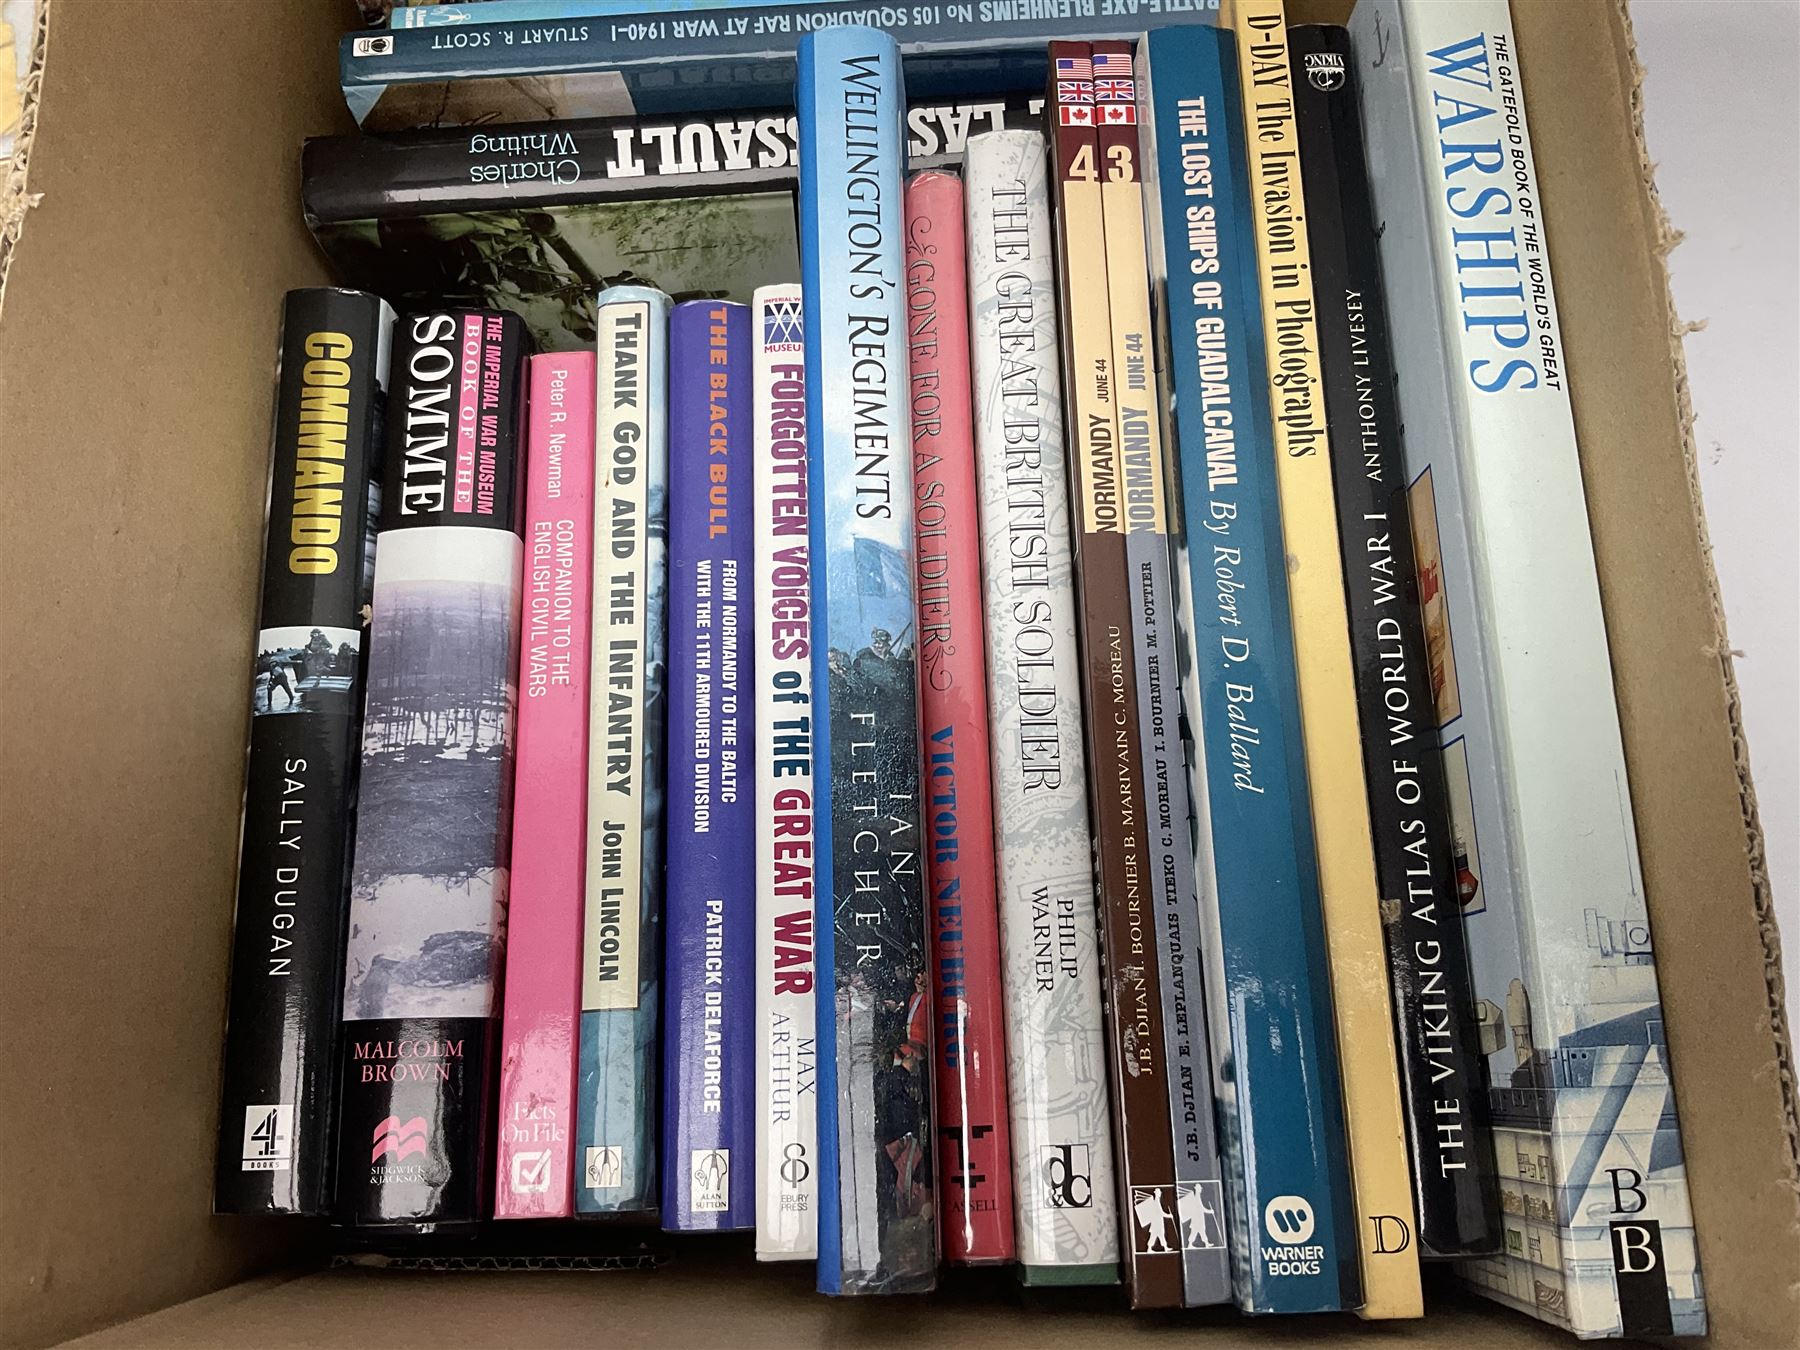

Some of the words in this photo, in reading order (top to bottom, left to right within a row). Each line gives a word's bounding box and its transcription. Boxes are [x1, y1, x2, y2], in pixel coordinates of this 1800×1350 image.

[498, 30, 515, 46] R.
[521, 26, 589, 45] STUART
[672, 18, 720, 38] WAR
[724, 17, 749, 36] AT
[754, 14, 791, 35] RAF
[796, 8, 907, 32] SQUADRON
[913, 6, 941, 26] 105
[950, 4, 973, 22] No
[980, 0, 1096, 21] BLENHEIMS
[431, 31, 491, 51] SCOTT
[1247, 13, 1289, 89] D-DAY
[1493, 33, 1510, 62] THE
[1178, 96, 1208, 137] THE
[1255, 97, 1297, 142] The
[1498, 64, 1522, 145] GATEFOLD
[469, 131, 580, 158] Whiting
[1069, 145, 1098, 182] 4
[1108, 145, 1135, 182] 3
[1181, 142, 1213, 199] LOST
[1510, 148, 1530, 193] BOOK
[470, 159, 581, 189] Charles
[840, 53, 896, 300] WELLINGTON'S
[1260, 149, 1303, 253] Invasion
[991, 179, 1029, 263] THE
[1424, 31, 1539, 394] WARSHIPS
[1518, 197, 1534, 220] OF
[1186, 205, 1218, 276] SHIPS
[1522, 223, 1541, 252] THE
[1192, 281, 1223, 310] OF
[1270, 263, 1308, 290] in
[1527, 258, 1551, 331] WORLD'S
[487, 316, 503, 341] THE
[709, 307, 728, 365] THE
[907, 259, 939, 365] GONE
[995, 269, 1039, 408] GREAT
[1346, 289, 1369, 368] LIVESEY
[462, 323, 481, 394] BOOK
[613, 312, 642, 409] THANK
[764, 343, 803, 353] MUSEU
[1096, 358, 1108, 375] 44
[1125, 332, 1144, 354] 44
[1539, 333, 1561, 392] GREAT
[481, 344, 502, 410] IMPERIAL
[550, 368, 568, 405] Peter
[1099, 375, 1110, 403] JUNE
[1127, 356, 1147, 391] JUNE
[1273, 298, 1326, 459] Photographs
[401, 313, 457, 516] SOMME
[459, 407, 476, 440] OF
[479, 414, 498, 447] WAR
[551, 410, 567, 431] R.
[709, 372, 728, 456] BLACK
[847, 313, 892, 520] REGIMENTS
[911, 372, 941, 437] FOR
[1195, 316, 1238, 492] GUADALCANAL
[1356, 374, 1383, 483] ANTHONY
[288, 331, 353, 576] COMMANDO
[457, 451, 473, 504] THE
[547, 433, 566, 499] Newman
[612, 420, 641, 485] GOD
[771, 363, 807, 537] FORGOTTEN
[914, 453, 942, 474] A
[1089, 413, 1120, 534] NORMANDY
[1121, 406, 1157, 534] NORMANDY
[477, 450, 495, 514] MUSEUM
[709, 466, 728, 540] BULL
[1003, 414, 1050, 591] BRITISH
[611, 497, 636, 559] AND
[1203, 499, 1241, 536] By
[532, 521, 552, 596] ENGLISH
[553, 519, 575, 619] COMPANION
[697, 559, 712, 597] WITH
[722, 559, 738, 601] FROM
[916, 481, 952, 648] SOLDIER
[1212, 546, 1246, 627] Robert
[1367, 532, 1398, 608] WAR
[530, 598, 549, 642] CIVIL
[609, 571, 636, 626] THE
[697, 601, 711, 628] THE
[770, 545, 810, 661] VOICES
[1139, 561, 1158, 627] POTTIER
[553, 621, 571, 647] TO
[696, 632, 711, 669] 11TH
[722, 605, 737, 691] NORMANDY
[1145, 629, 1159, 649] M.
[1220, 633, 1251, 670] D.
[528, 644, 547, 697] WARS
[551, 649, 570, 686] THE
[772, 671, 809, 703] of
[1107, 624, 1125, 704] MOREAU
[1377, 617, 1416, 747] WORLD
[606, 638, 635, 797] INFANTRY
[695, 673, 711, 759] ARMOURED
[722, 695, 737, 713] TO
[1013, 600, 1063, 795] SOLDIER
[1114, 708, 1127, 726] C.
[1146, 654, 1167, 738] BOURNIER
[721, 718, 736, 746] THE
[772, 715, 810, 777] THE
[1225, 680, 1265, 794] Ballard
[279, 758, 308, 851] SALLY
[695, 763, 710, 833] DIVISION
[721, 750, 737, 803] BALTIC
[930, 725, 960, 870] VICTOR
[1115, 729, 1134, 826] MARIVAIN
[1154, 758, 1174, 829] MOREAU
[1393, 757, 1422, 806] OF
[600, 819, 626, 879] JOHN
[772, 788, 812, 900] GREAT
[849, 711, 882, 967] FLETCHER
[889, 793, 915, 876] IAN
[1122, 831, 1136, 848] B.
[1159, 832, 1175, 848] C.
[1161, 854, 1178, 906] TIEKO
[1400, 818, 1438, 925] ATLAS
[268, 867, 299, 977] DUGAN
[1124, 854, 1144, 955] BOURNIER
[599, 888, 625, 982] LINCOLN
[703, 899, 724, 986] PATRICK
[773, 911, 813, 997] WAR
[1031, 885, 1055, 995] WARNER
[1056, 898, 1079, 980] PHILIP
[1166, 912, 1190, 1037] LEPLANQUAIS
[1132, 979, 1150, 1037] DJIAN
[1413, 939, 1462, 1086] VIKING
[354, 1040, 464, 1060] MALCOLM
[361, 1062, 452, 1083] BROWN
[703, 990, 722, 1113] DELAFORCE
[772, 1011, 792, 1126] ARTHUR
[797, 1038, 816, 1097] MAX
[1136, 1043, 1153, 1076] J.B.
[1178, 1040, 1192, 1057] E.
[514, 1101, 556, 1121] Facts
[1179, 1065, 1197, 1124] DJIAN
[502, 1124, 529, 1143] On
[534, 1122, 565, 1142] File
[1184, 1127, 1200, 1162] J.B.
[1435, 1098, 1468, 1179] THE
[250, 1161, 280, 1169] BOOKS
[371, 1165, 426, 1175] SIDGWICK
[1605, 1168, 1648, 1214] B
[695, 1201, 728, 1210] SUTTON
[701, 1193, 723, 1201] ALAN
[781, 1194, 809, 1202] EBURY
[781, 1203, 808, 1212] PRESS
[1262, 1245, 1324, 1261] WARNER
[1369, 1215, 1410, 1254] D
[1613, 1226, 1656, 1273] B
[1268, 1260, 1321, 1276] BOOKS
